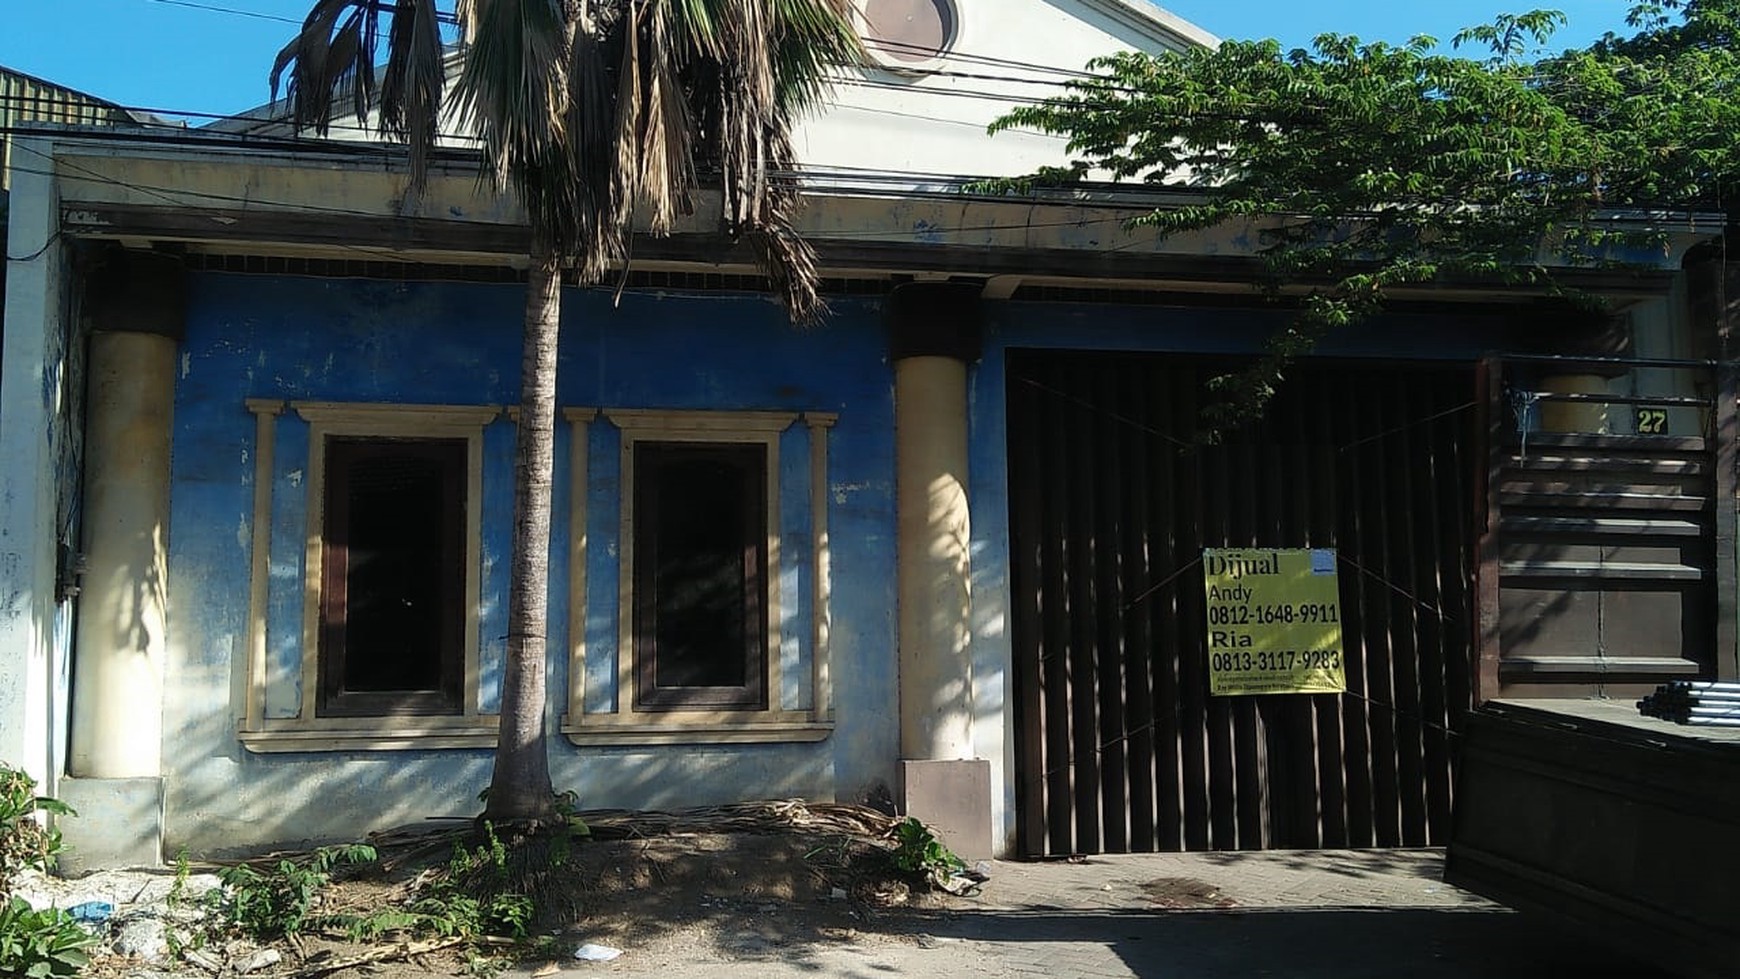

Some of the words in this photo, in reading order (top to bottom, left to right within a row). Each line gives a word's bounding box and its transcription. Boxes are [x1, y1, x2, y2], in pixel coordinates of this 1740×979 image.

[1638, 410, 1666, 433] 27
[1209, 552, 1280, 579] Dijual
[1209, 584, 1252, 604] Andy
[1209, 604, 1339, 625] 0812-1648-9911
[1211, 630, 1252, 648] Ria
[1212, 651, 1340, 672] 0813-3117-9283
